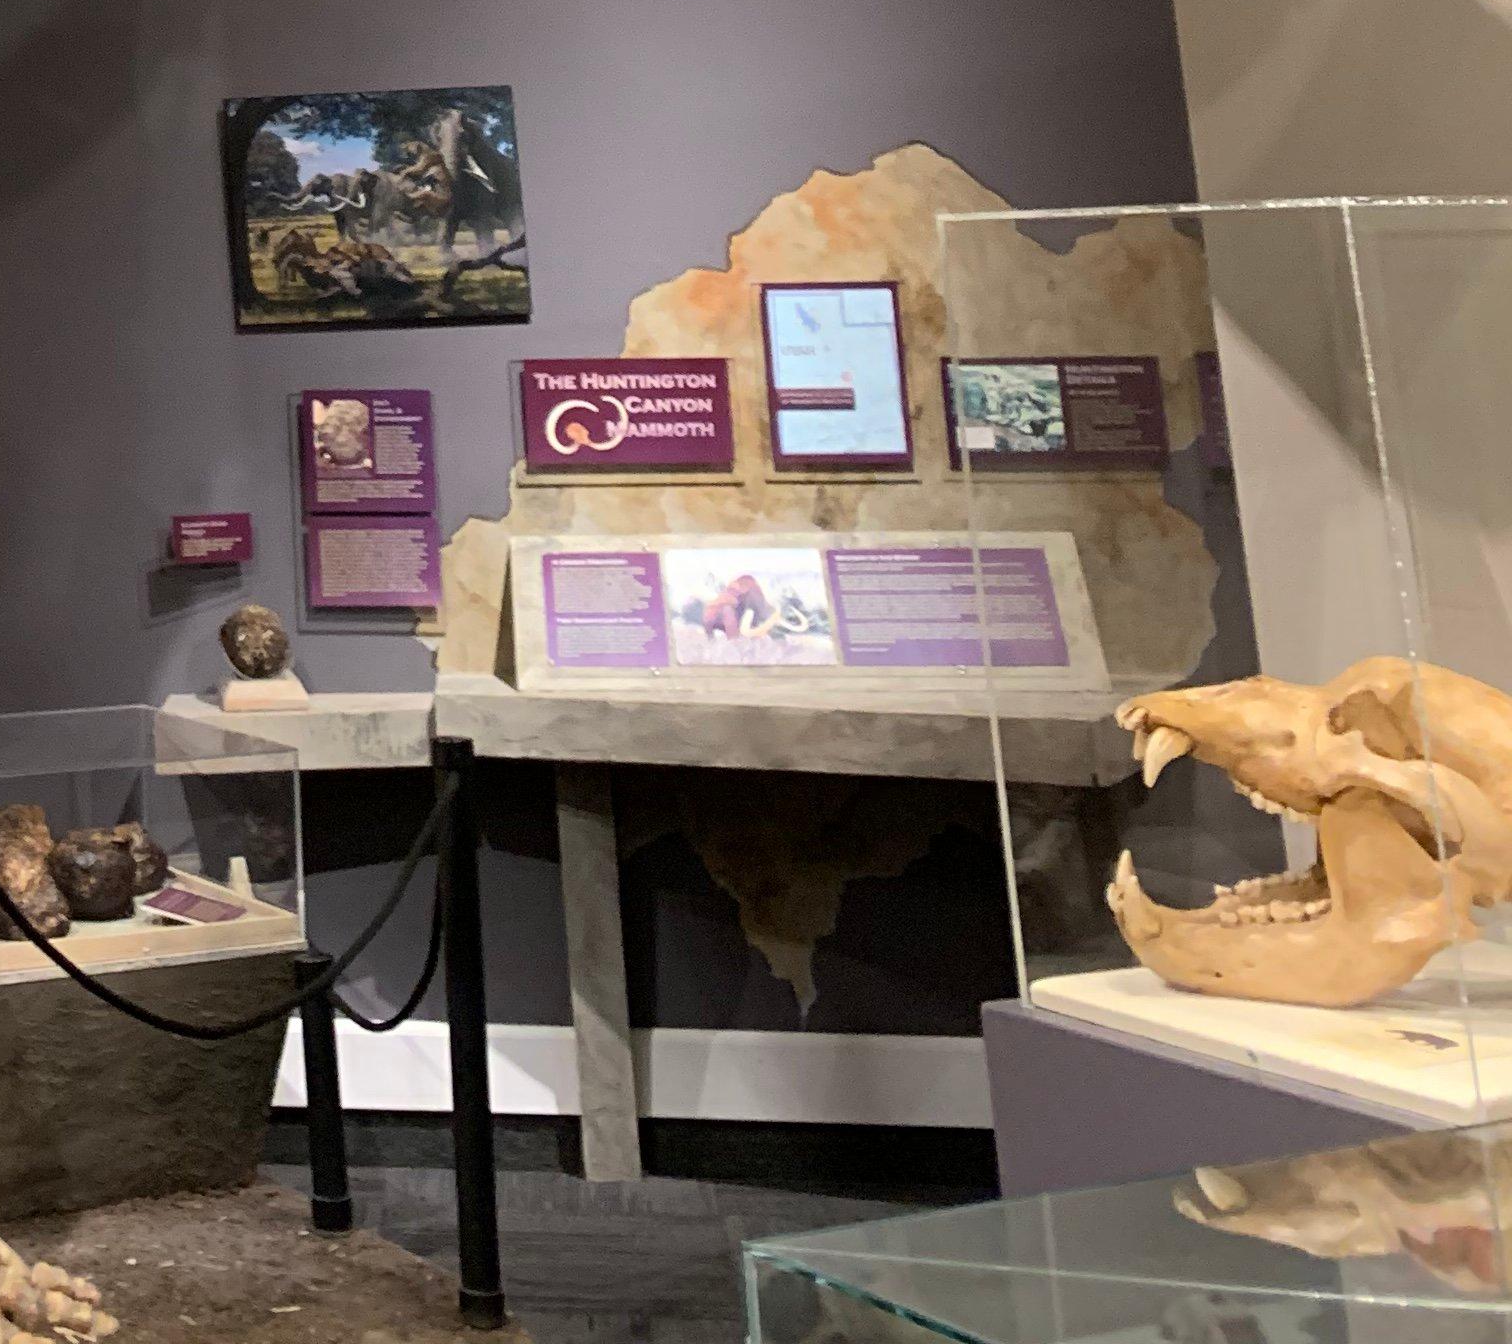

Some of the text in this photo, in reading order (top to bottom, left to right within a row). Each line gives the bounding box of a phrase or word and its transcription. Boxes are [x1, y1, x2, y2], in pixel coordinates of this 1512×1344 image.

[532, 372, 717, 390] THE HUNTINGTON
[623, 396, 713, 414] CANYON
[605, 420, 715, 438] MAMMOTH
